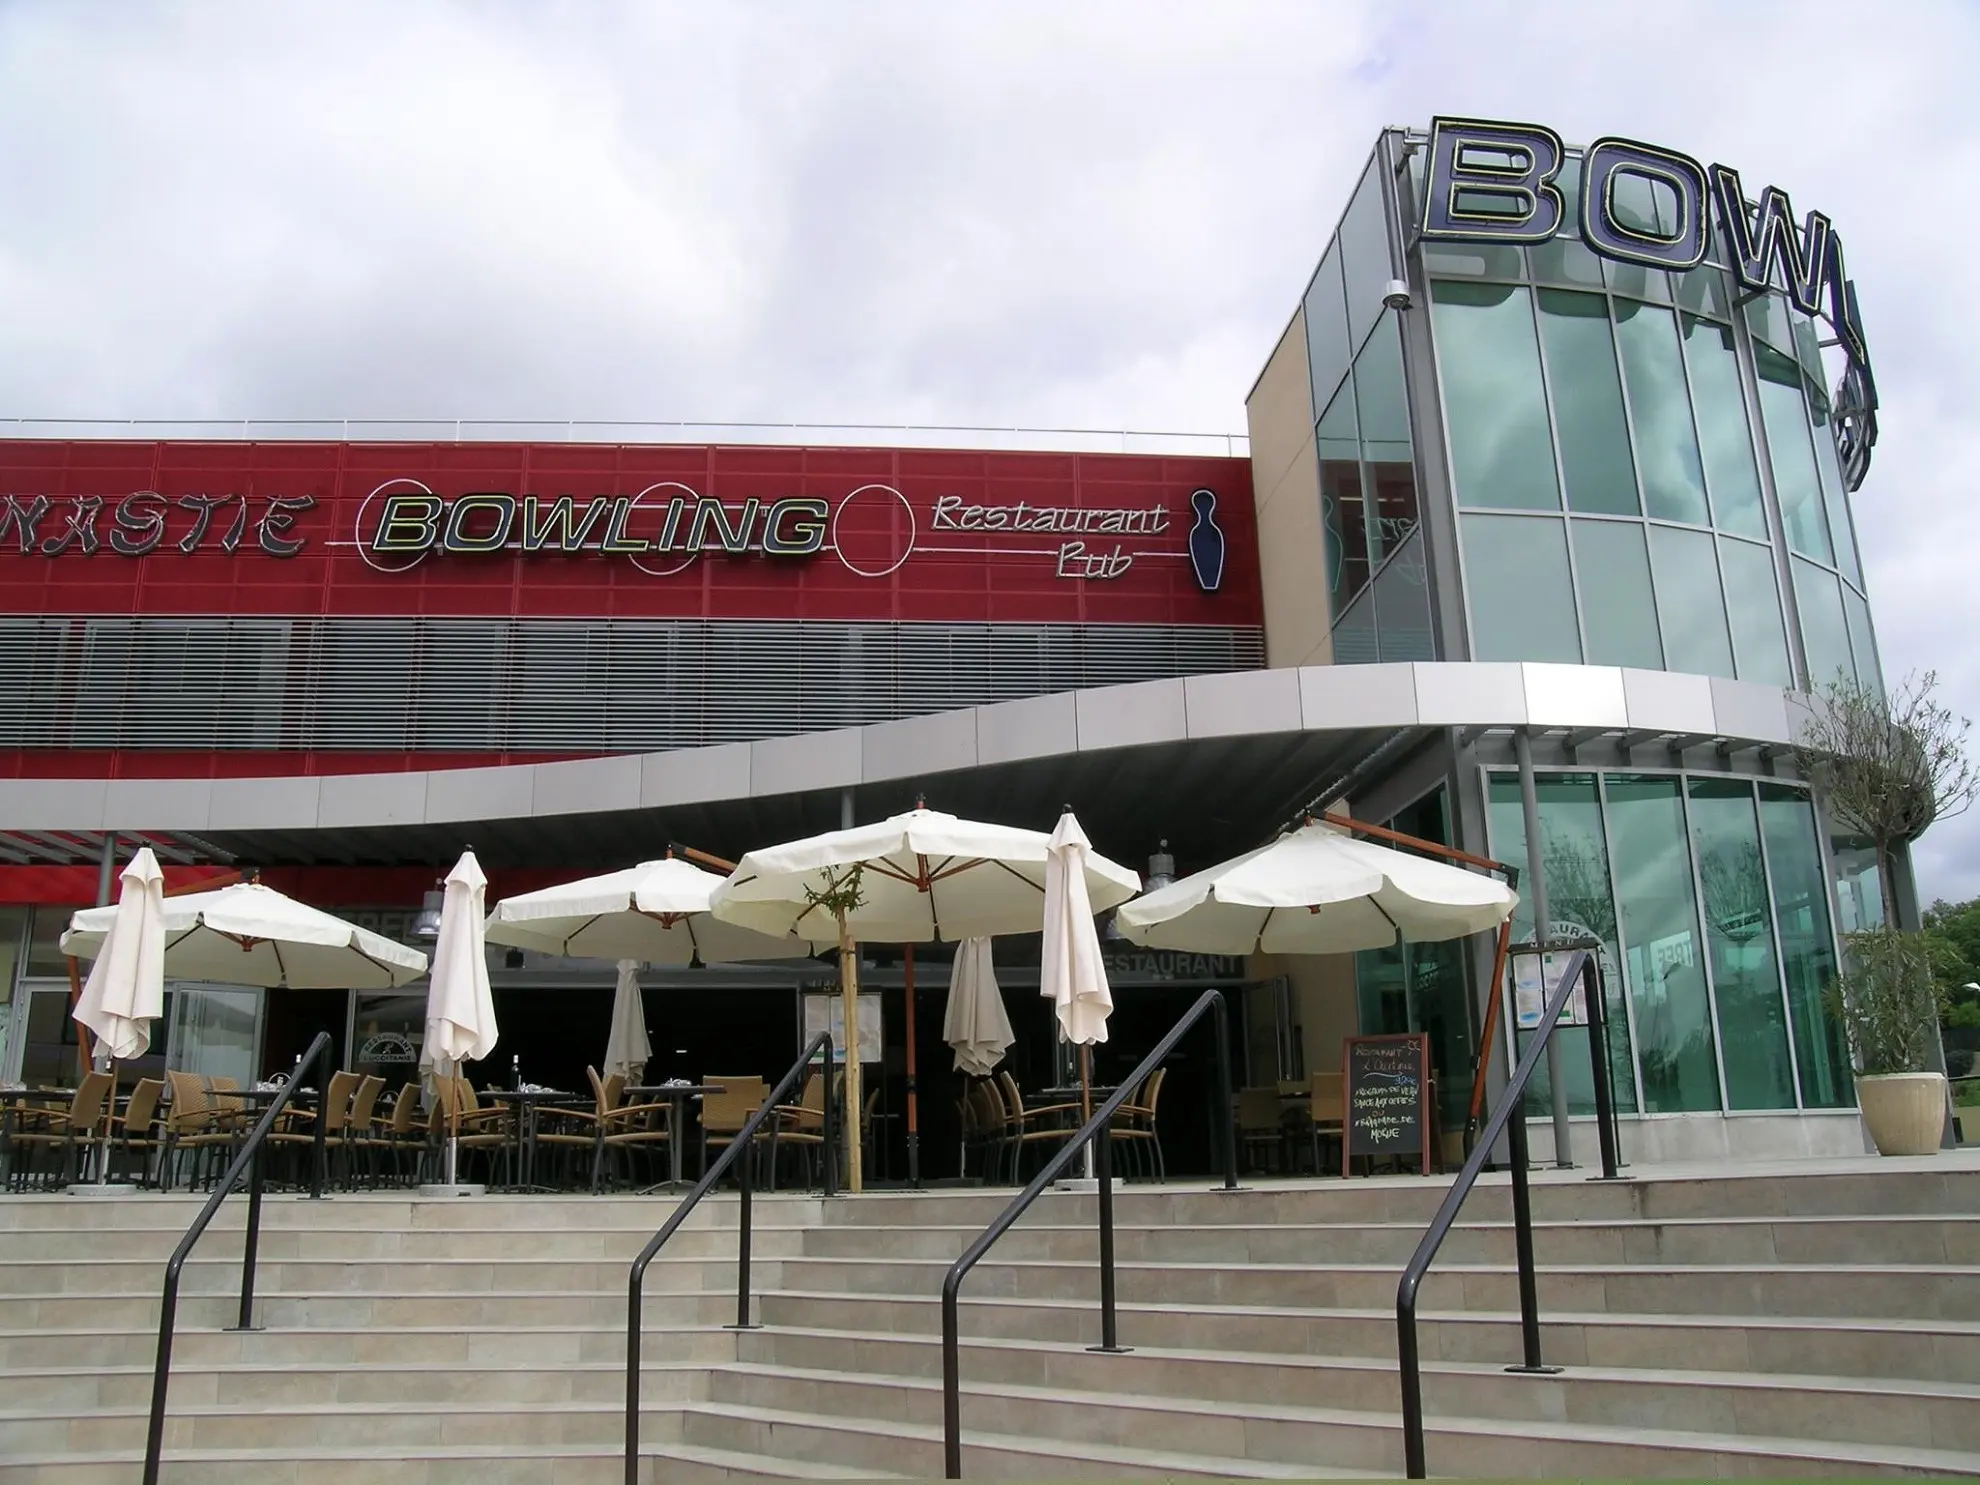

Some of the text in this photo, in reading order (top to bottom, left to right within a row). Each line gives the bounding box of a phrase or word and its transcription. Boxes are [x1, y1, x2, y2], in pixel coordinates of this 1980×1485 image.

[371, 494, 831, 555] BOWLING
[931, 495, 1171, 533] Restaurant
[1056, 541, 1133, 577] Pub
[1104, 952, 1237, 974] ESTAURANT
